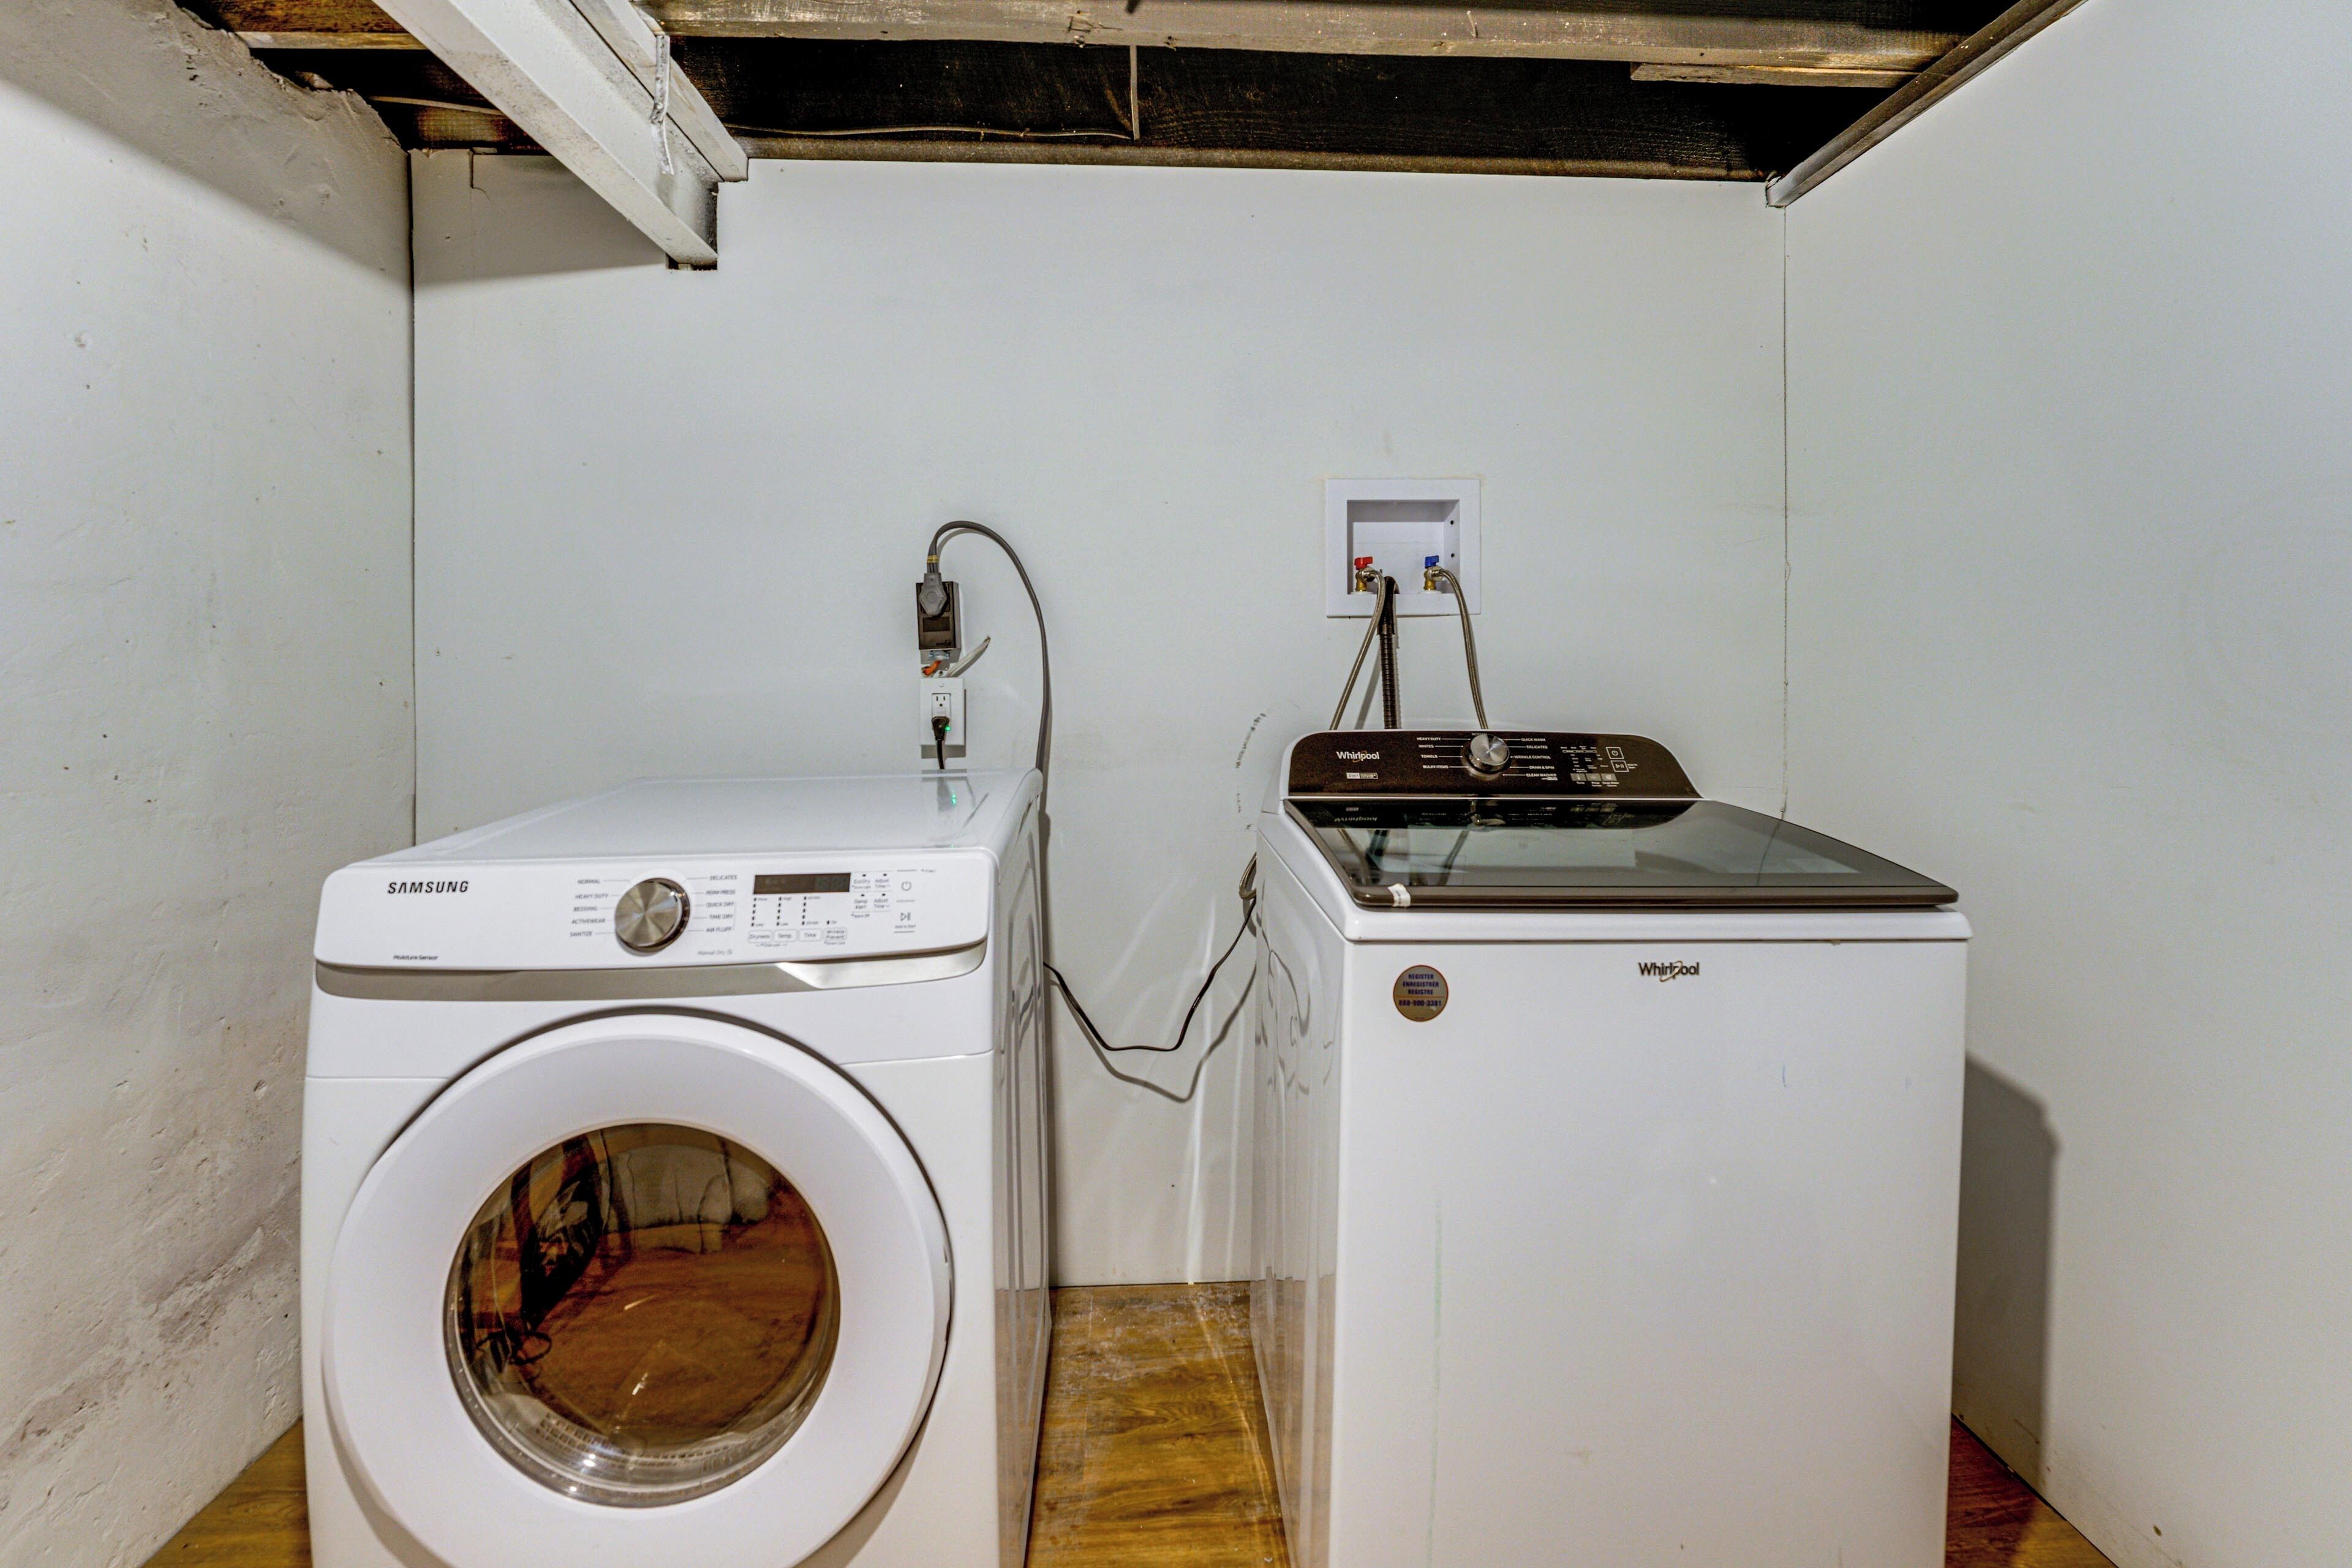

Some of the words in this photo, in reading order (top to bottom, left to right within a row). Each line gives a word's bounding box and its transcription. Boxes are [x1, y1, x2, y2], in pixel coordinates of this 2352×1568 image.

[1336, 751, 1380, 762] Whirlpool
[388, 881, 469, 894] SAMSUNG
[1638, 961, 1700, 981] Whirlpool
